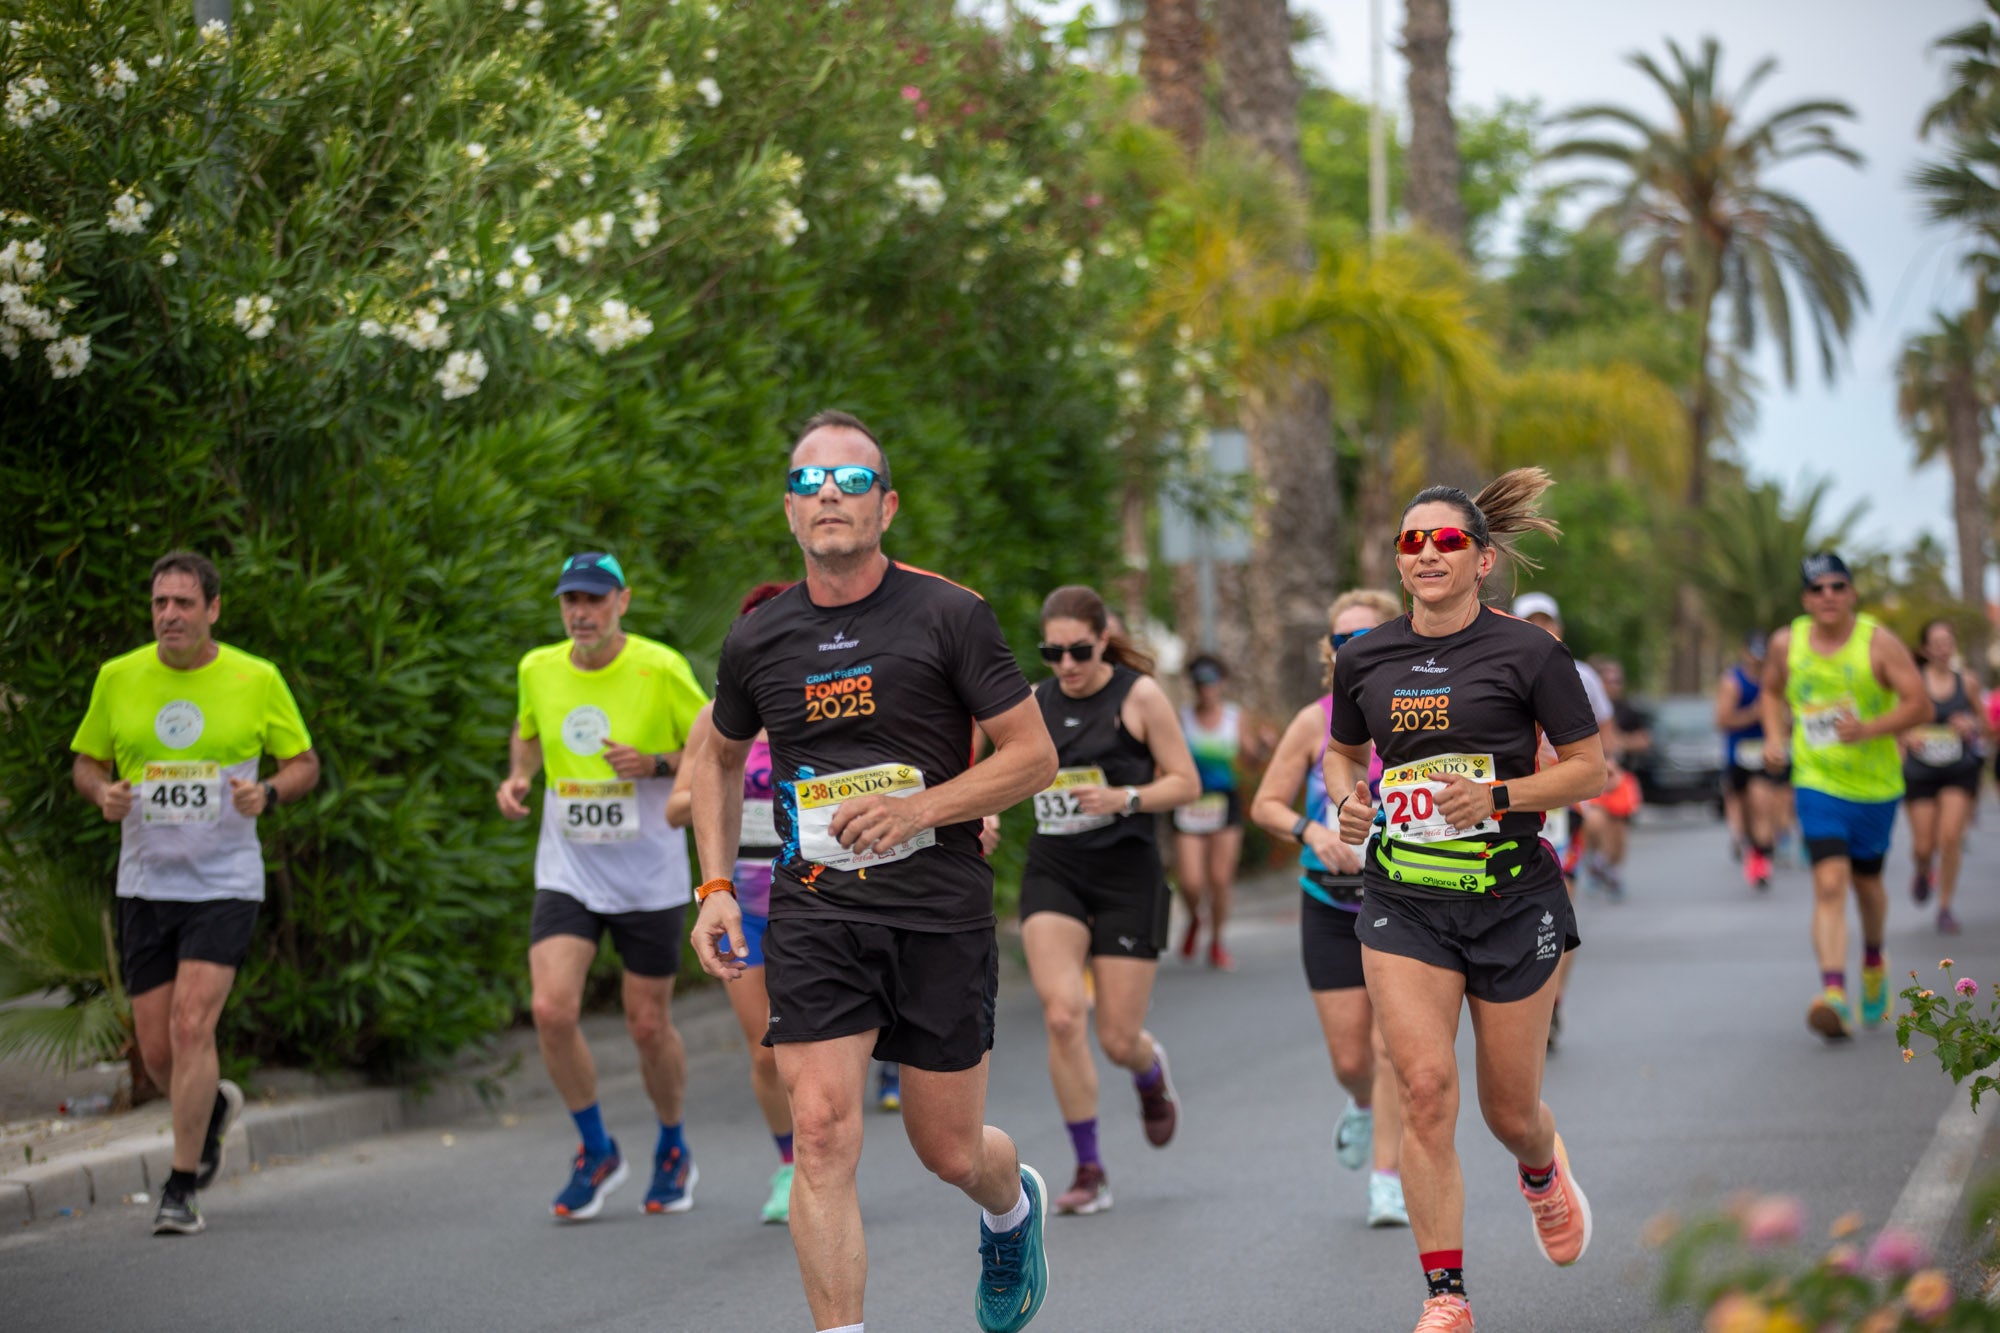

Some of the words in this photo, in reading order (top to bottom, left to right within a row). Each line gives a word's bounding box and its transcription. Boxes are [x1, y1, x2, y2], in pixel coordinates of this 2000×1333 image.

[806, 673, 832, 685] GRAN
[834, 665, 873, 680] PREMIO
[805, 675, 873, 701] FONDO
[1394, 688, 1419, 697] GRAN
[1420, 686, 1451, 696] PREMIO
[805, 692, 876, 722] 2025
[1391, 694, 1450, 711] FONDO
[1390, 709, 1450, 733] 2025
[1416, 761, 1434, 770] GRAN
[1435, 757, 1462, 765] PREMIO
[811, 783, 829, 801] 38
[828, 776, 892, 799] FONDO
[830, 776, 852, 786] GRAN
[854, 770, 885, 782] PREMIO
[151, 784, 208, 808] 463
[1386, 783, 1457, 825] 20
[568, 803, 623, 828] 506
